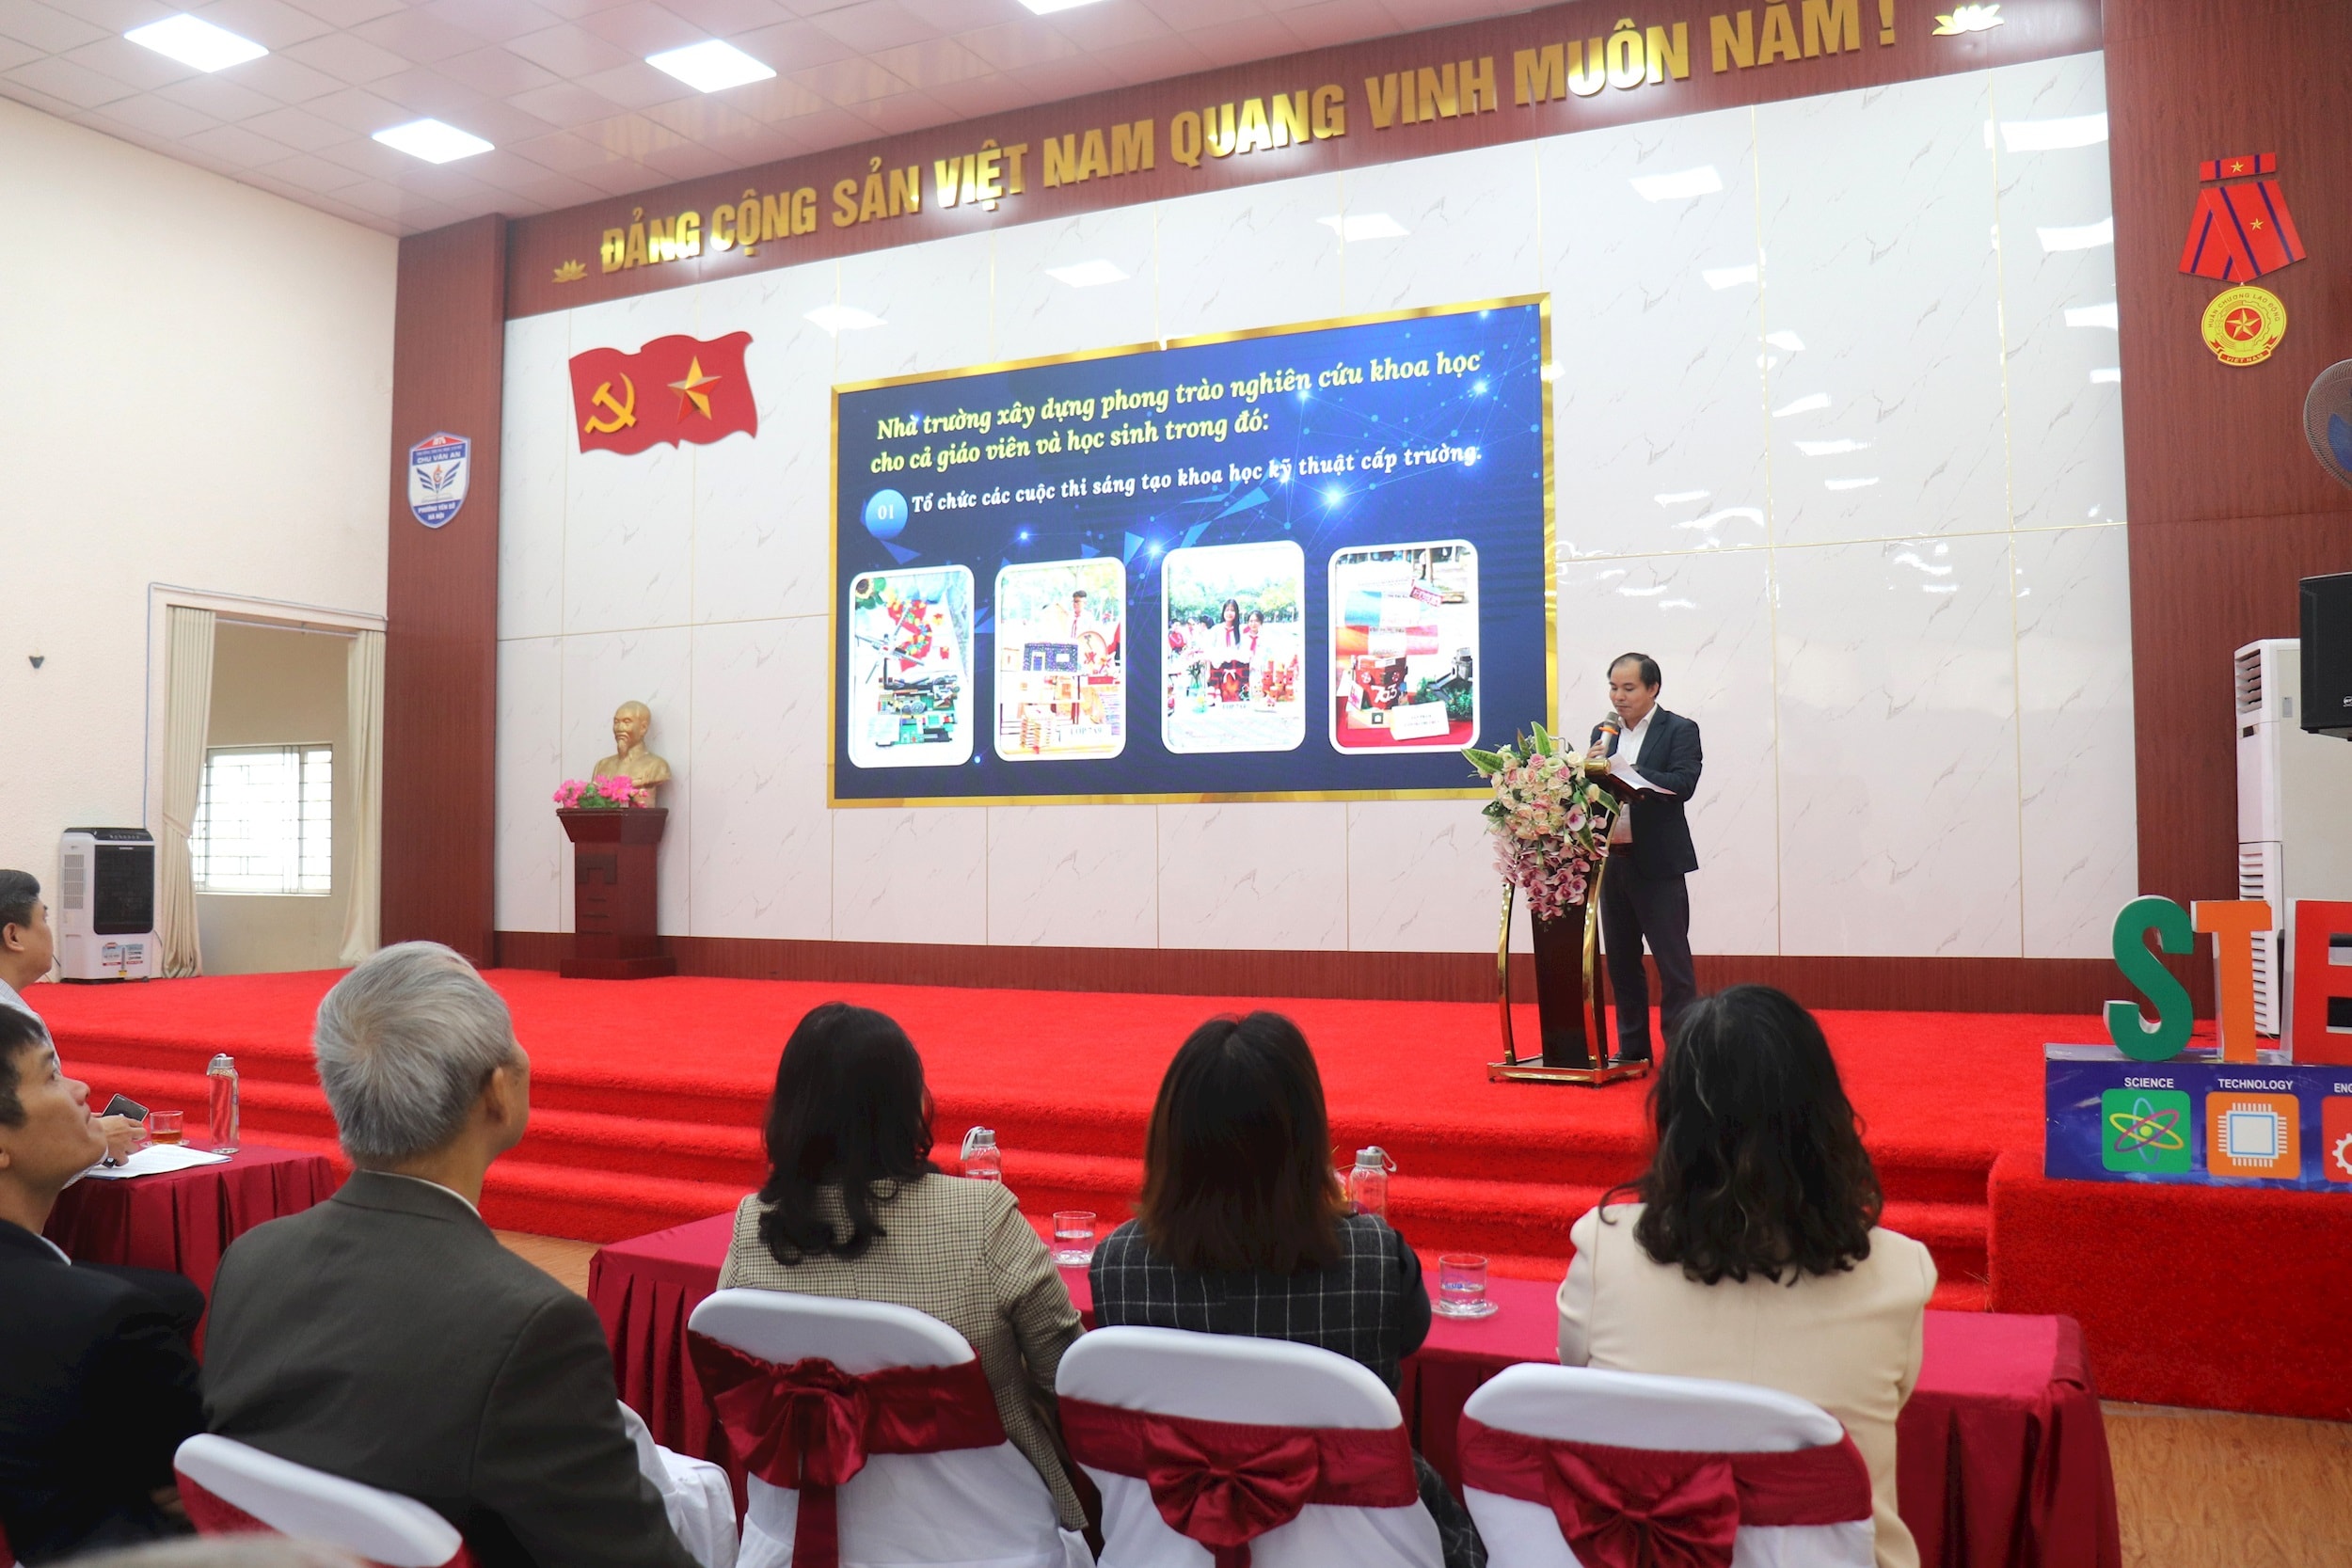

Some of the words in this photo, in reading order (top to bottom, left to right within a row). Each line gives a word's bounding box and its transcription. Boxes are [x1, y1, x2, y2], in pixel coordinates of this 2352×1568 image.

[601, 207, 702, 274] ĐẢNG
[709, 188, 818, 257] CỘNG
[832, 157, 921, 228] SẢN
[933, 140, 1029, 212] VIỆT
[1043, 119, 1154, 187] NAM
[1170, 85, 1345, 169] QUANG
[1364, 55, 1498, 130] VINH
[1514, 18, 1690, 103] MUÔN
[877, 415, 918, 440] Nhà
[923, 407, 992, 435] trường
[996, 401, 1035, 428] xây
[1041, 396, 1095, 421] dựng
[1101, 388, 1169, 419] phong
[1176, 377, 1224, 404] trào
[1230, 368, 1311, 403] nghiên
[1318, 362, 1363, 388] cứu
[1370, 356, 1430, 384] khoa
[1437, 351, 1481, 380] học
[870, 451, 904, 473] cho
[909, 446, 932, 468] cả
[936, 445, 980, 472] giáo
[985, 436, 1031, 459] viên
[1036, 433, 1062, 455] và
[1068, 428, 1104, 454] học
[1110, 420, 1159, 447] sinh
[1166, 418, 1227, 443] trong
[1233, 410, 1269, 435] đó:
[878, 501, 895, 521] 01
[912, 491, 933, 514] Tổ
[937, 488, 977, 510] chức
[981, 489, 1010, 506] các
[1015, 484, 1056, 502] cuộc
[1061, 477, 1088, 499] thi
[1092, 474, 1136, 498] sáng
[1141, 471, 1172, 493] tạo
[1177, 467, 1223, 488] khoa
[1229, 463, 1263, 484] học
[1268, 457, 1293, 483] kỹ
[1298, 451, 1356, 475] thuật
[1360, 446, 1398, 473] cấp
[1403, 444, 1483, 468] trường.
[2124, 1077, 2174, 1088] SCIENCE
[2218, 1079, 2293, 1090] TECHNOLOGY
